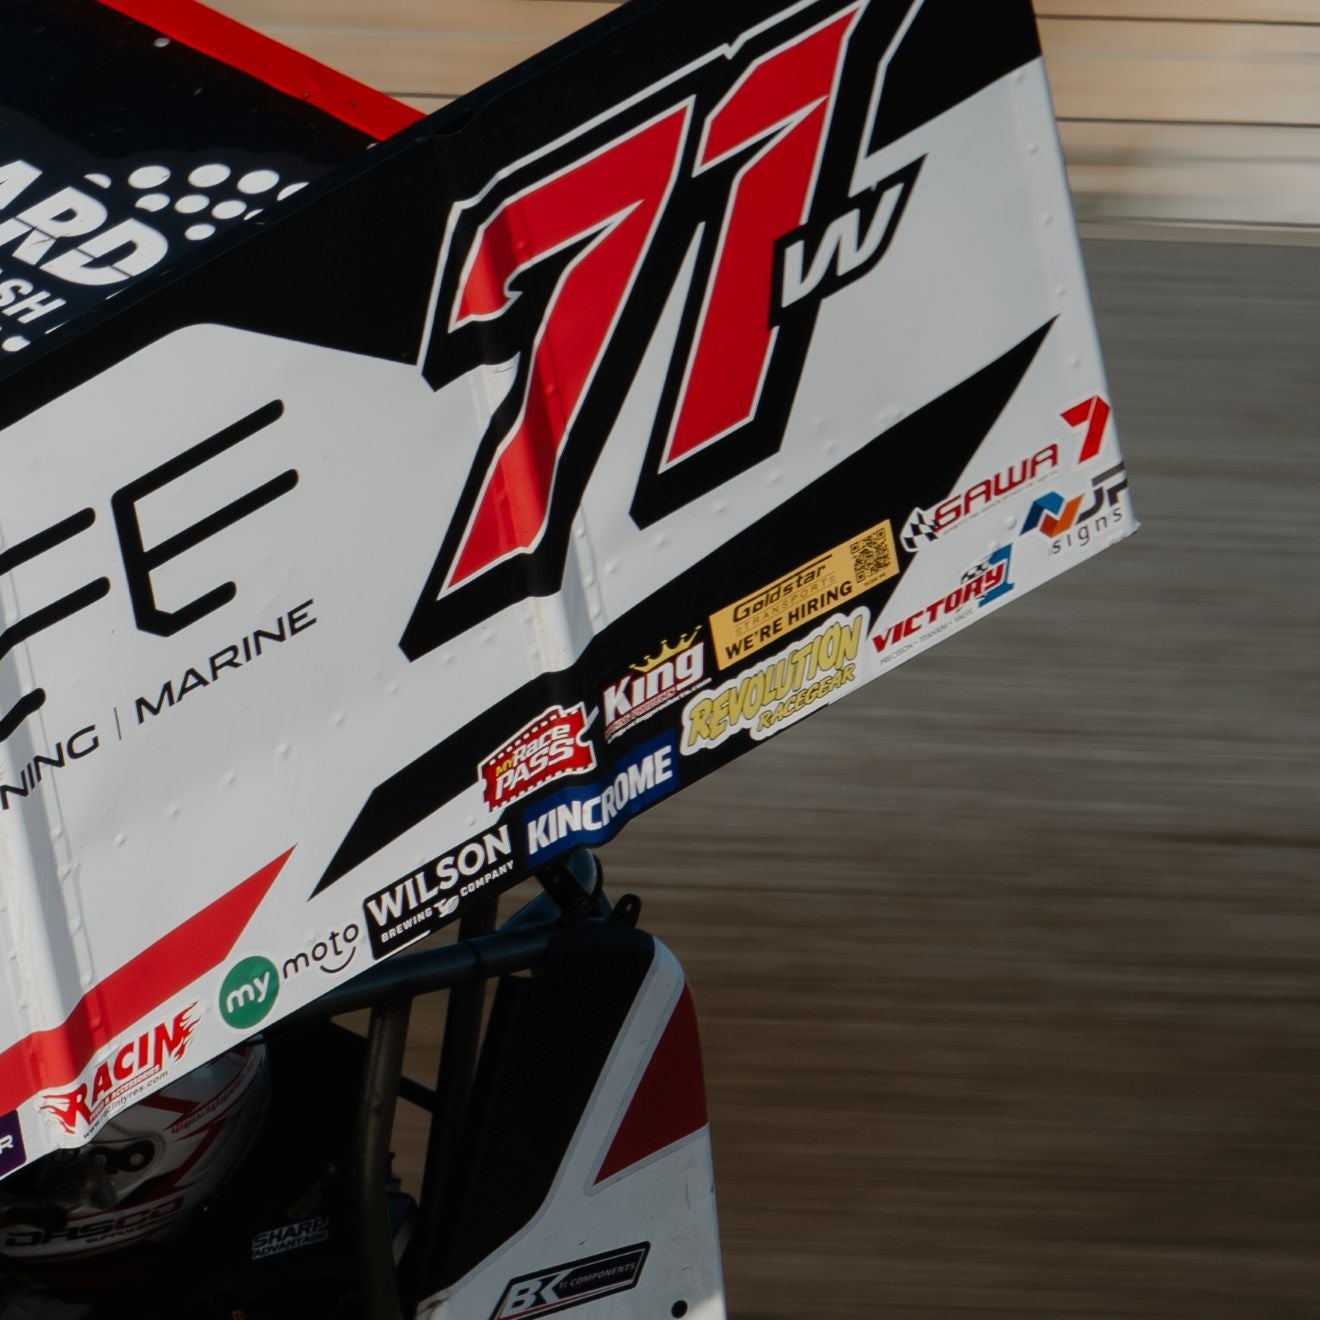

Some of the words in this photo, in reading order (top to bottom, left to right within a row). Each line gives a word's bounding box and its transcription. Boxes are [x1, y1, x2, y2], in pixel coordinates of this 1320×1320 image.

[932, 443, 1058, 533] SAWA
[1052, 507, 1122, 554] signs
[725, 617, 784, 660] WE'RE
[788, 580, 853, 626] HIRING
[732, 554, 832, 623] Goldstar
[872, 563, 1005, 653] VICTORY
[134, 599, 319, 725] MARINE
[603, 641, 704, 730] King
[688, 615, 863, 747] REVOLUTION
[757, 663, 856, 732] RACEGEAR
[495, 738, 574, 801] PASS
[527, 746, 674, 855] KINCROME
[366, 824, 512, 927] WILSON
[381, 907, 433, 943] BREWING
[460, 859, 515, 897] COMPANY
[225, 975, 271, 1015] my
[282, 922, 360, 978] moto
